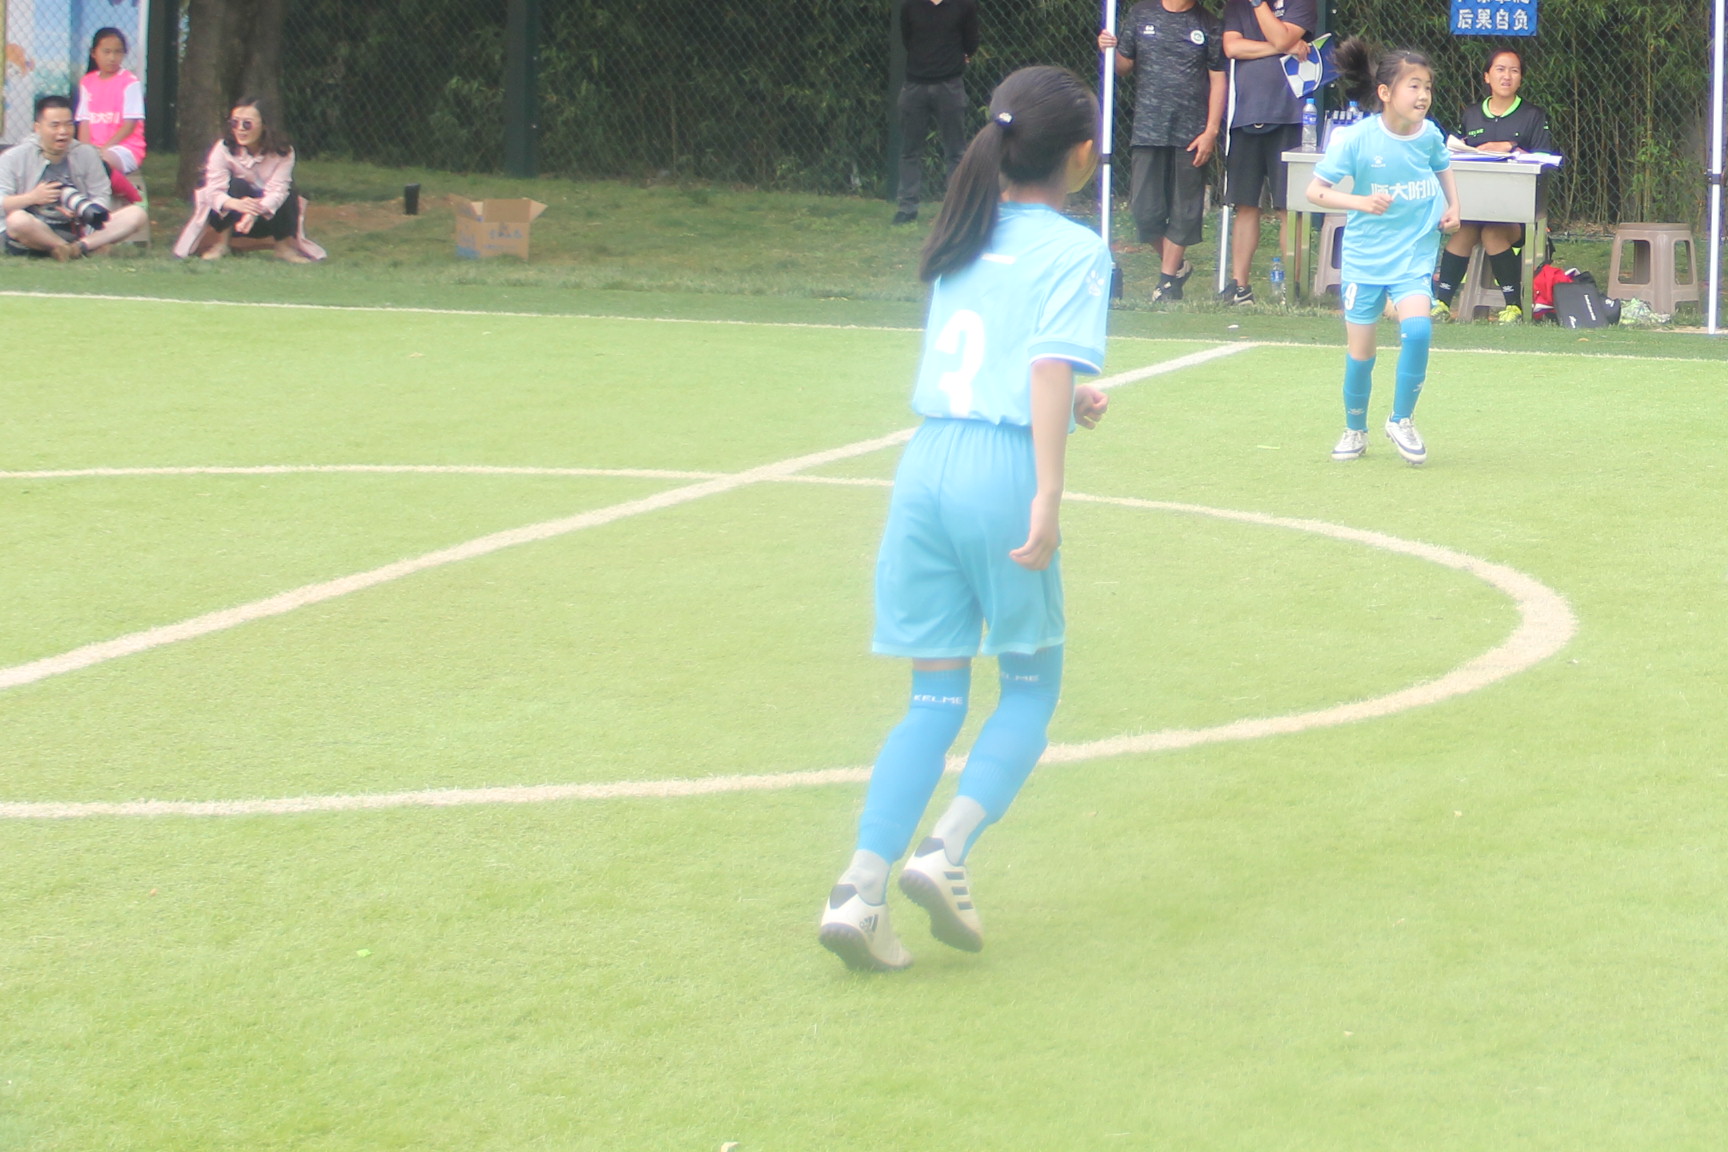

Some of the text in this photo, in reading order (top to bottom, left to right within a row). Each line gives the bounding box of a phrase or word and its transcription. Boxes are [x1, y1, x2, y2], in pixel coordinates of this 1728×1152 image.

[1457, 8, 1529, 30] 后果自负
[1345, 282, 1358, 310] 9
[913, 694, 963, 705] KELME
